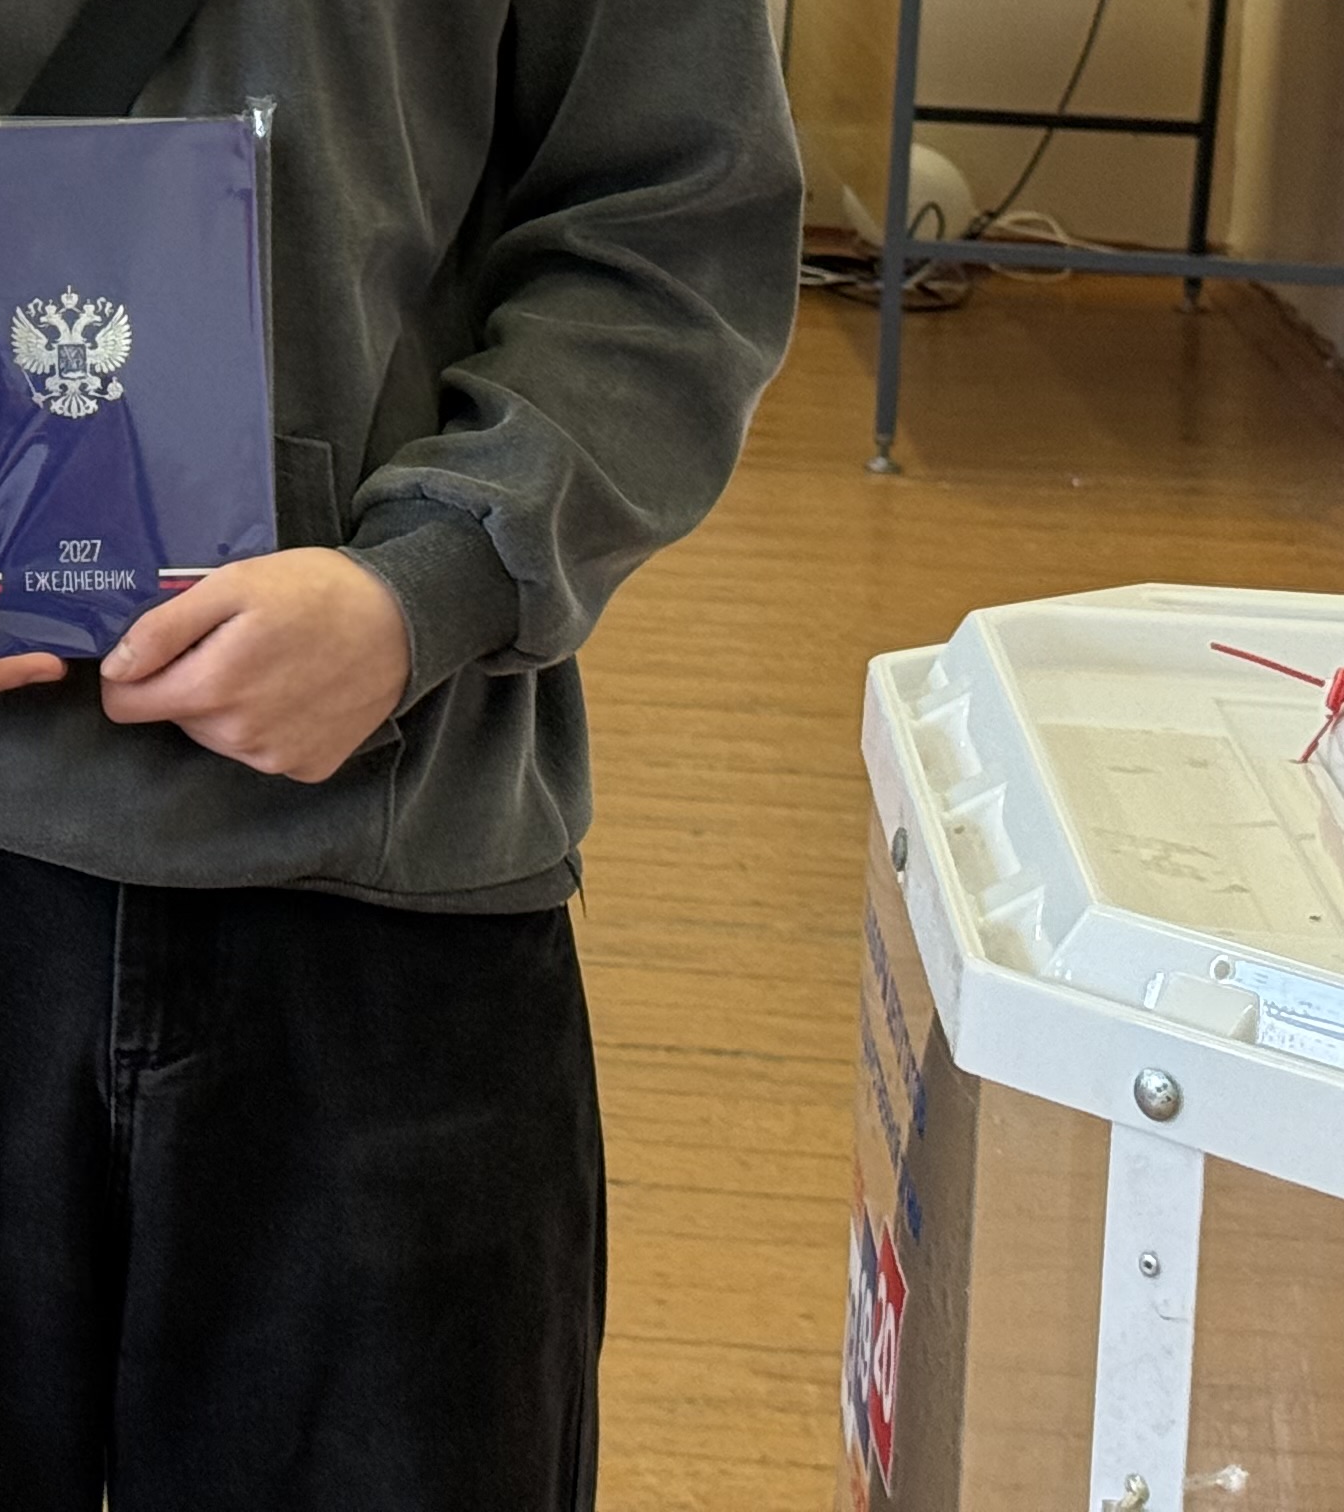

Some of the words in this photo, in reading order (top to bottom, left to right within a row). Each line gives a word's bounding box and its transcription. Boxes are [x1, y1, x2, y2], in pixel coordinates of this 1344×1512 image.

[58, 539, 102, 564] 2027
[24, 568, 137, 595] ЕЖЕДНЕВНИК
[873, 1271, 896, 1424] 20
